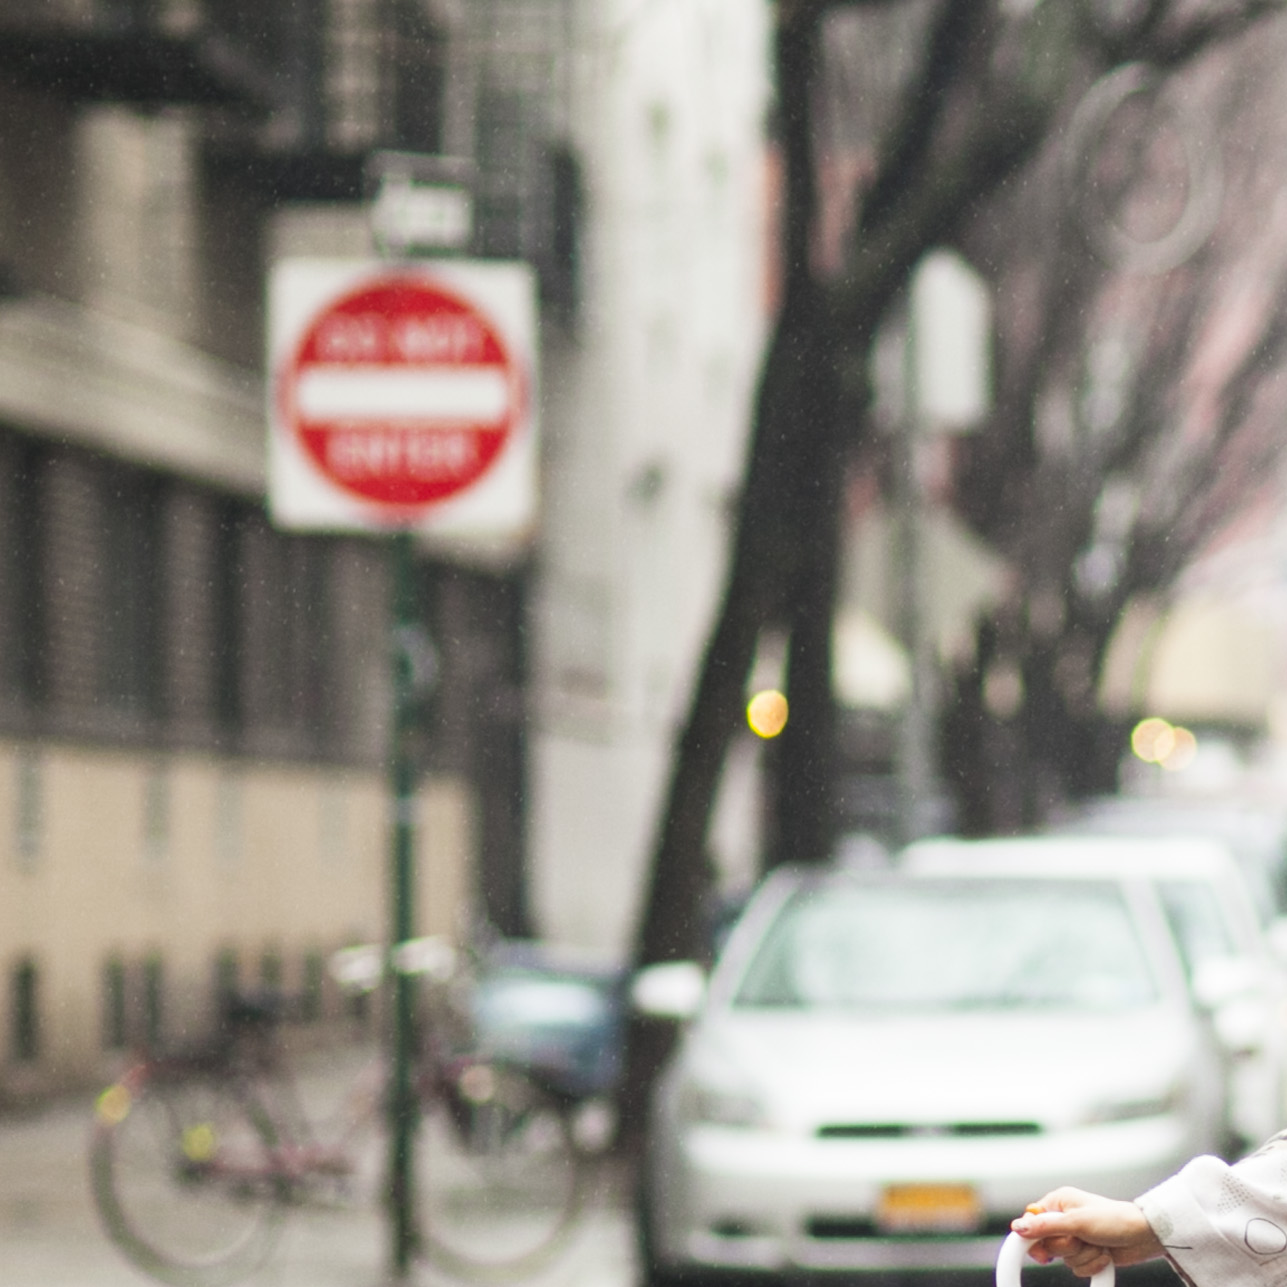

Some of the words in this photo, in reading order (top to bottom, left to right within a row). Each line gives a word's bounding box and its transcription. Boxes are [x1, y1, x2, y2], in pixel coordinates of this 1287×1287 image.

[314, 312, 388, 363] DO
[393, 312, 485, 364] NOT
[326, 428, 480, 481] ENTER
